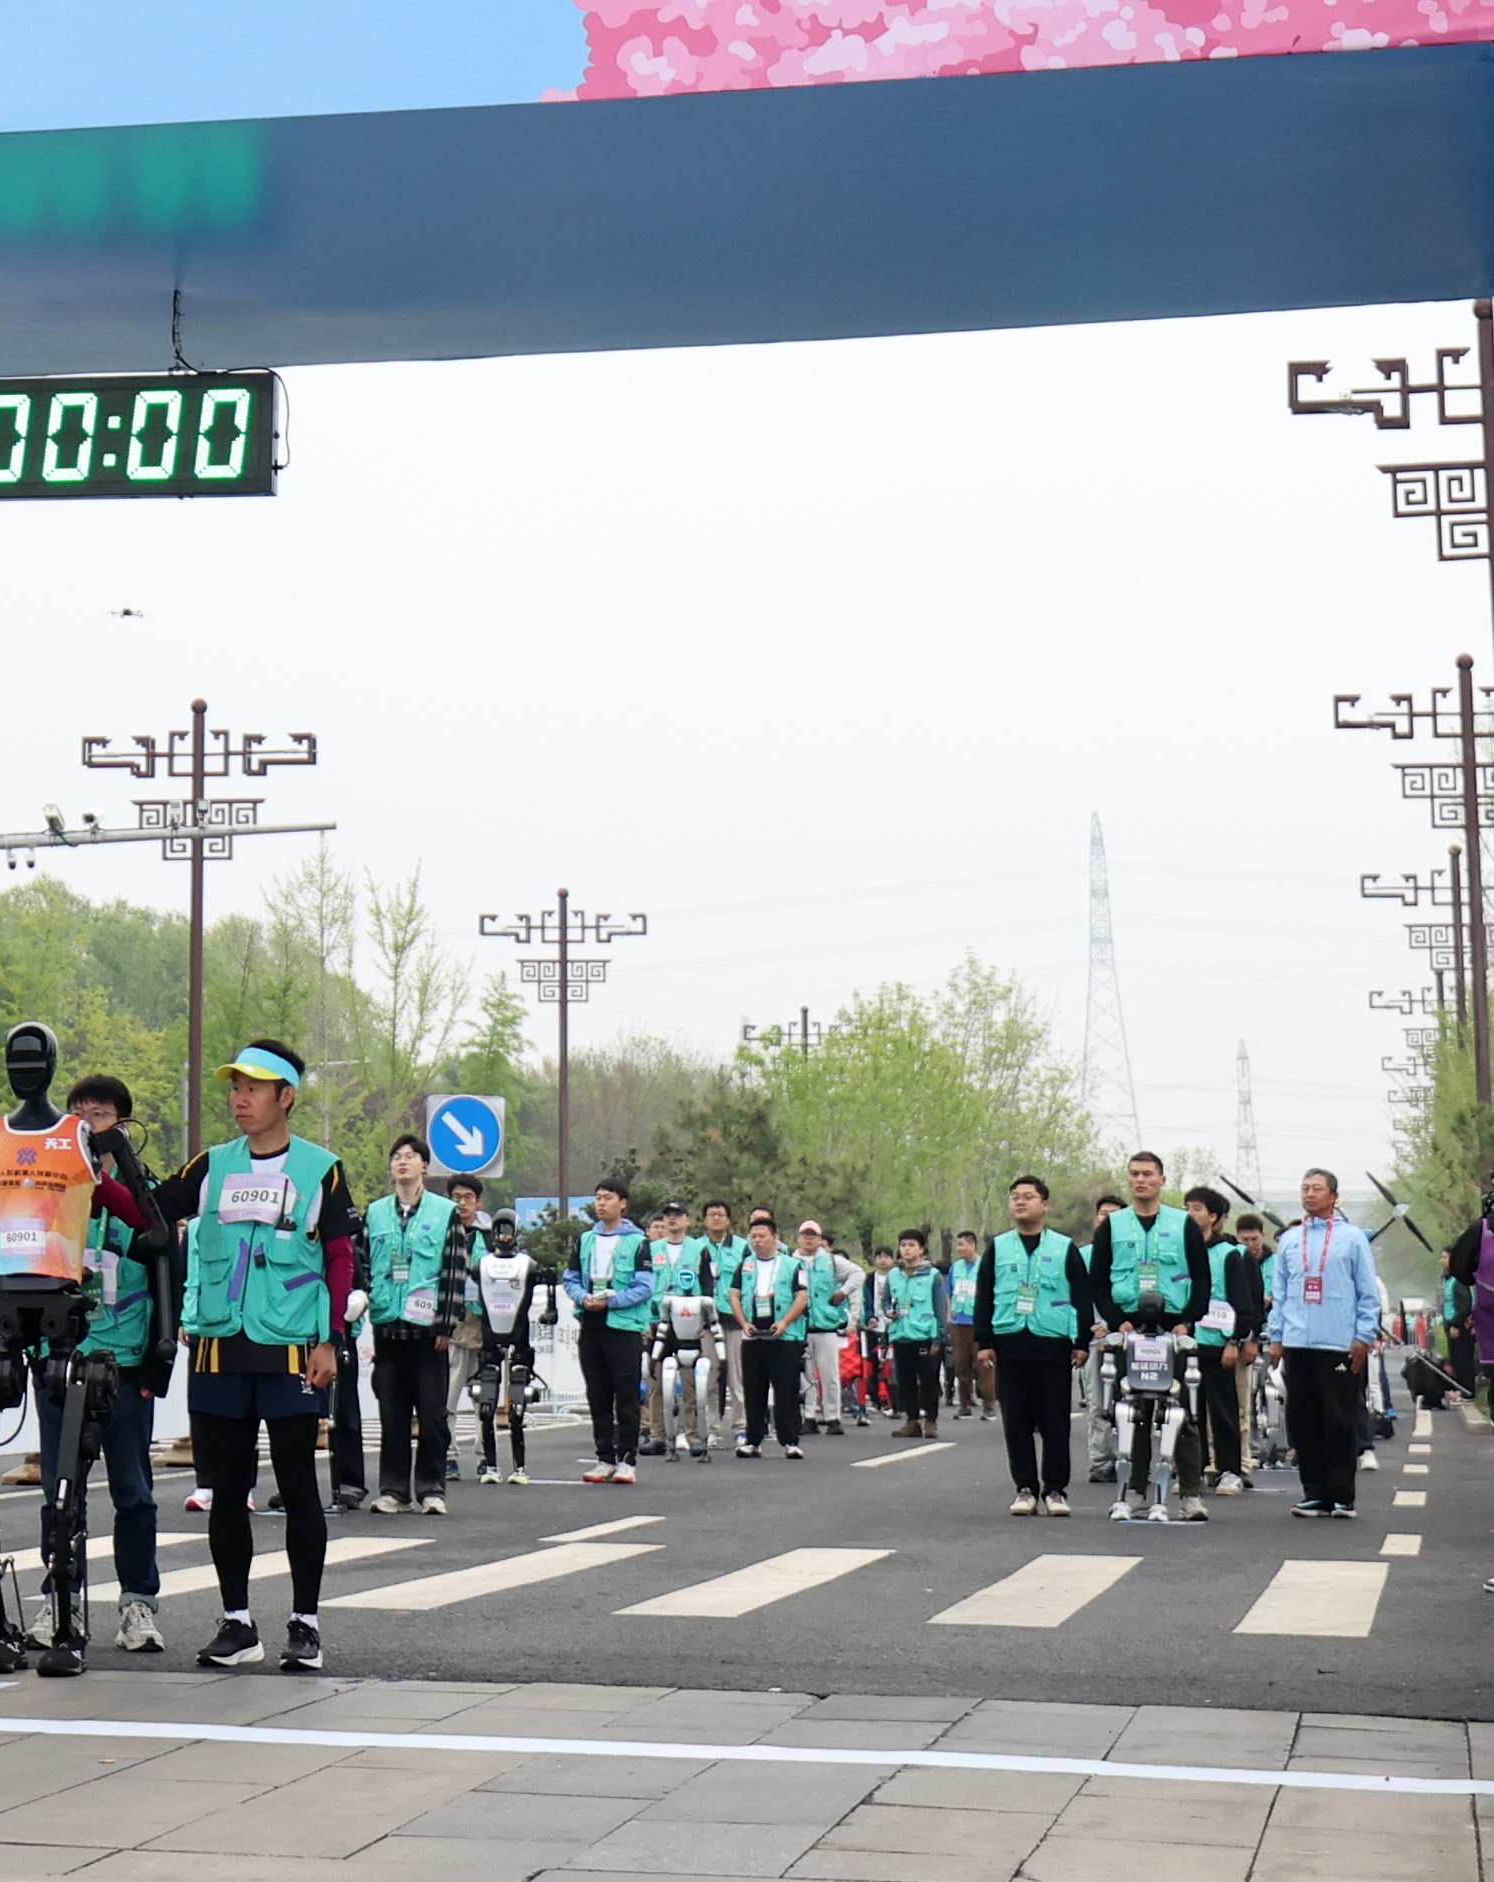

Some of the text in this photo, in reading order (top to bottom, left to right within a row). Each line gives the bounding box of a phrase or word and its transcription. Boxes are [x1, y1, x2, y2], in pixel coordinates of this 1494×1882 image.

[231, 1189, 279, 1204] 60901
[6, 1231, 38, 1243] 60901
[414, 1299, 435, 1310] 609
[1210, 1310, 1227, 1319] 910
[1140, 1371, 1158, 1381] N2
